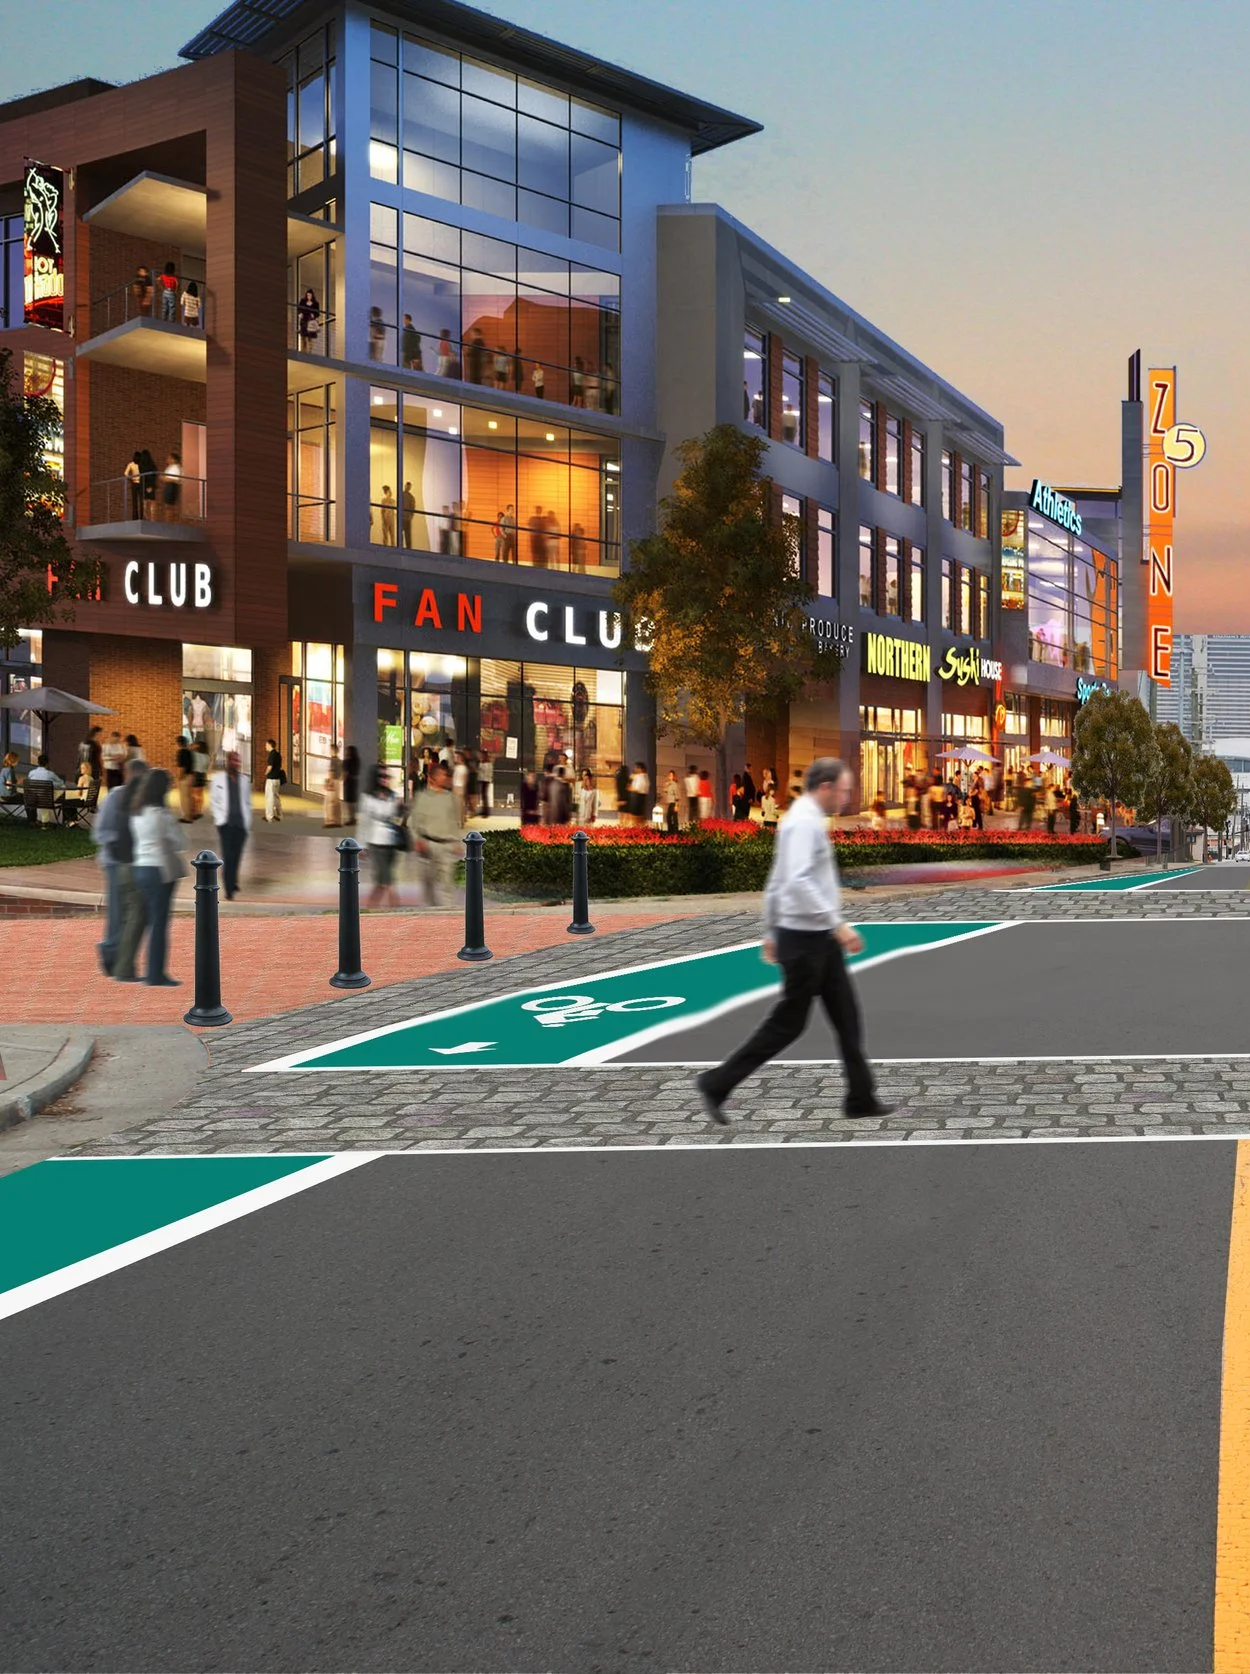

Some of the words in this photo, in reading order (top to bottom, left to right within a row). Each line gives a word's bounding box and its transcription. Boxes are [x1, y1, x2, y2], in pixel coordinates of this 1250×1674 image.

[1166, 427, 1199, 463] 5
[1032, 479, 1082, 536] Athletics
[1151, 382, 1173, 680] ZONE
[124, 560, 212, 608] CLUB
[373, 582, 482, 633] FAN
[867, 632, 931, 682] NORTHERN
[938, 646, 980, 686] Sushi
[980, 658, 1002, 681] HOUSE
